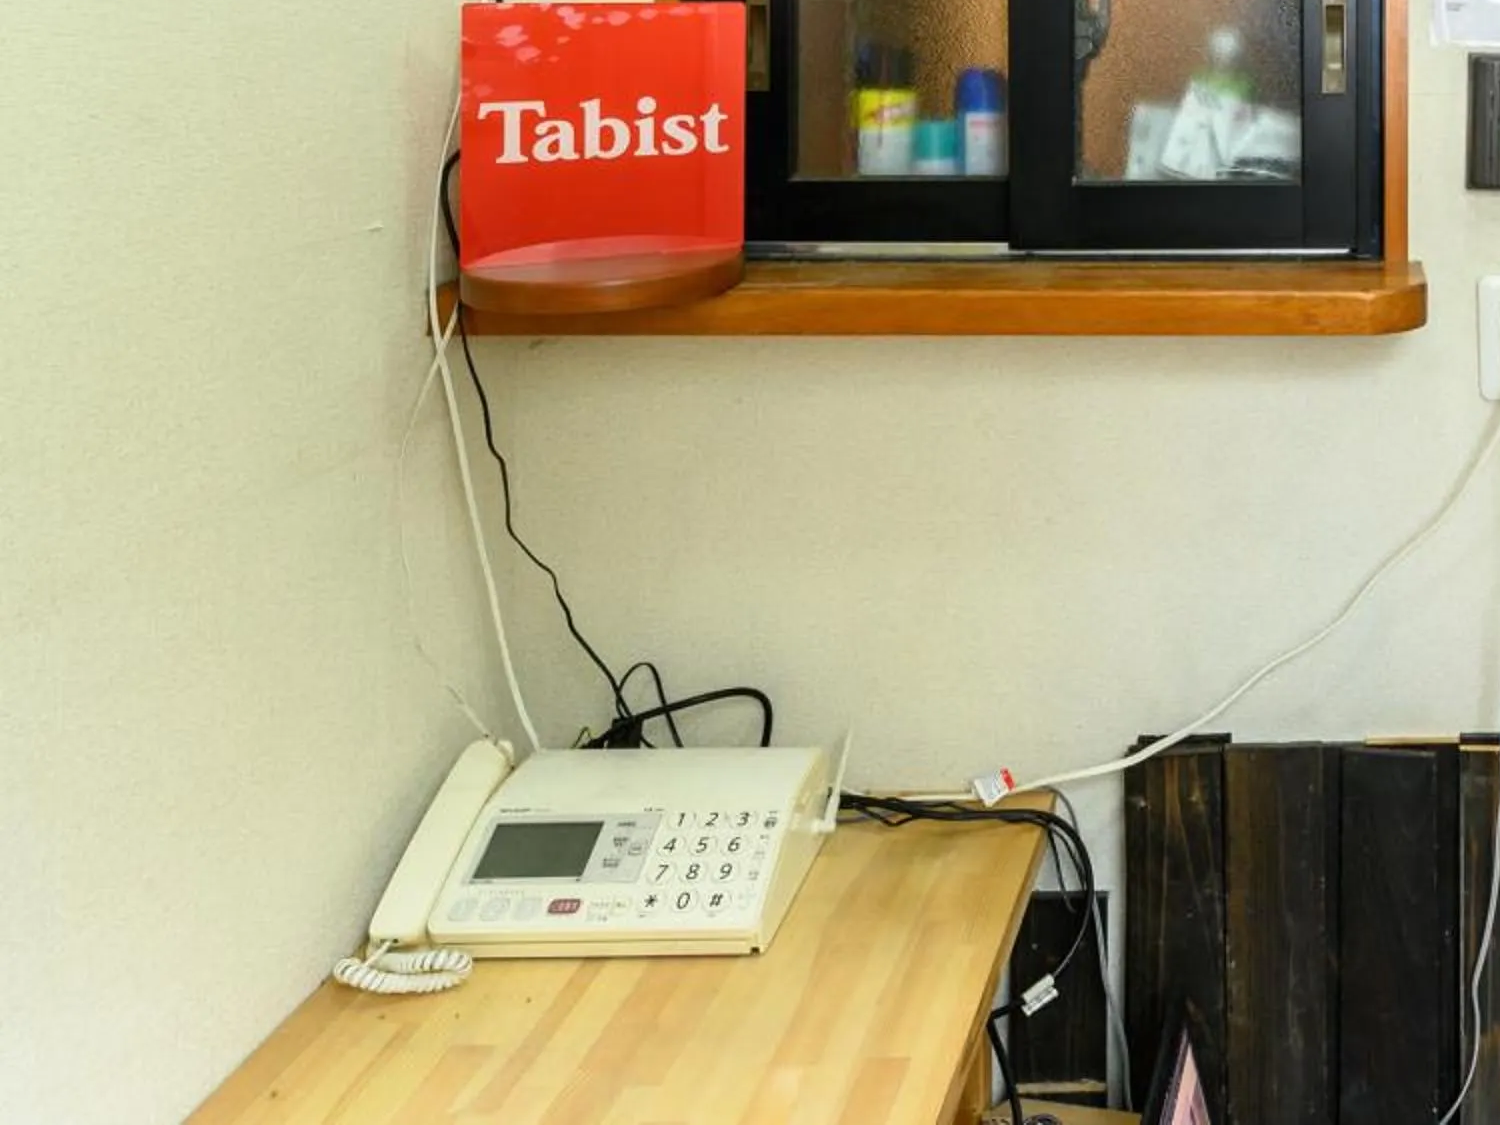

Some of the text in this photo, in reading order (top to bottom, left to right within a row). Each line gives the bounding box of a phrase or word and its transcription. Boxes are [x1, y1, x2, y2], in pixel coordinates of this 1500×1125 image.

[478, 96, 730, 164] Tabist
[677, 812, 686, 827] 1
[705, 812, 719, 826] 2
[737, 811, 750, 826] 3
[663, 836, 741, 853] 4 5 6
[655, 864, 669, 881] 7
[685, 863, 701, 880] 8
[719, 863, 733, 879] 9
[676, 892, 691, 910] 0
